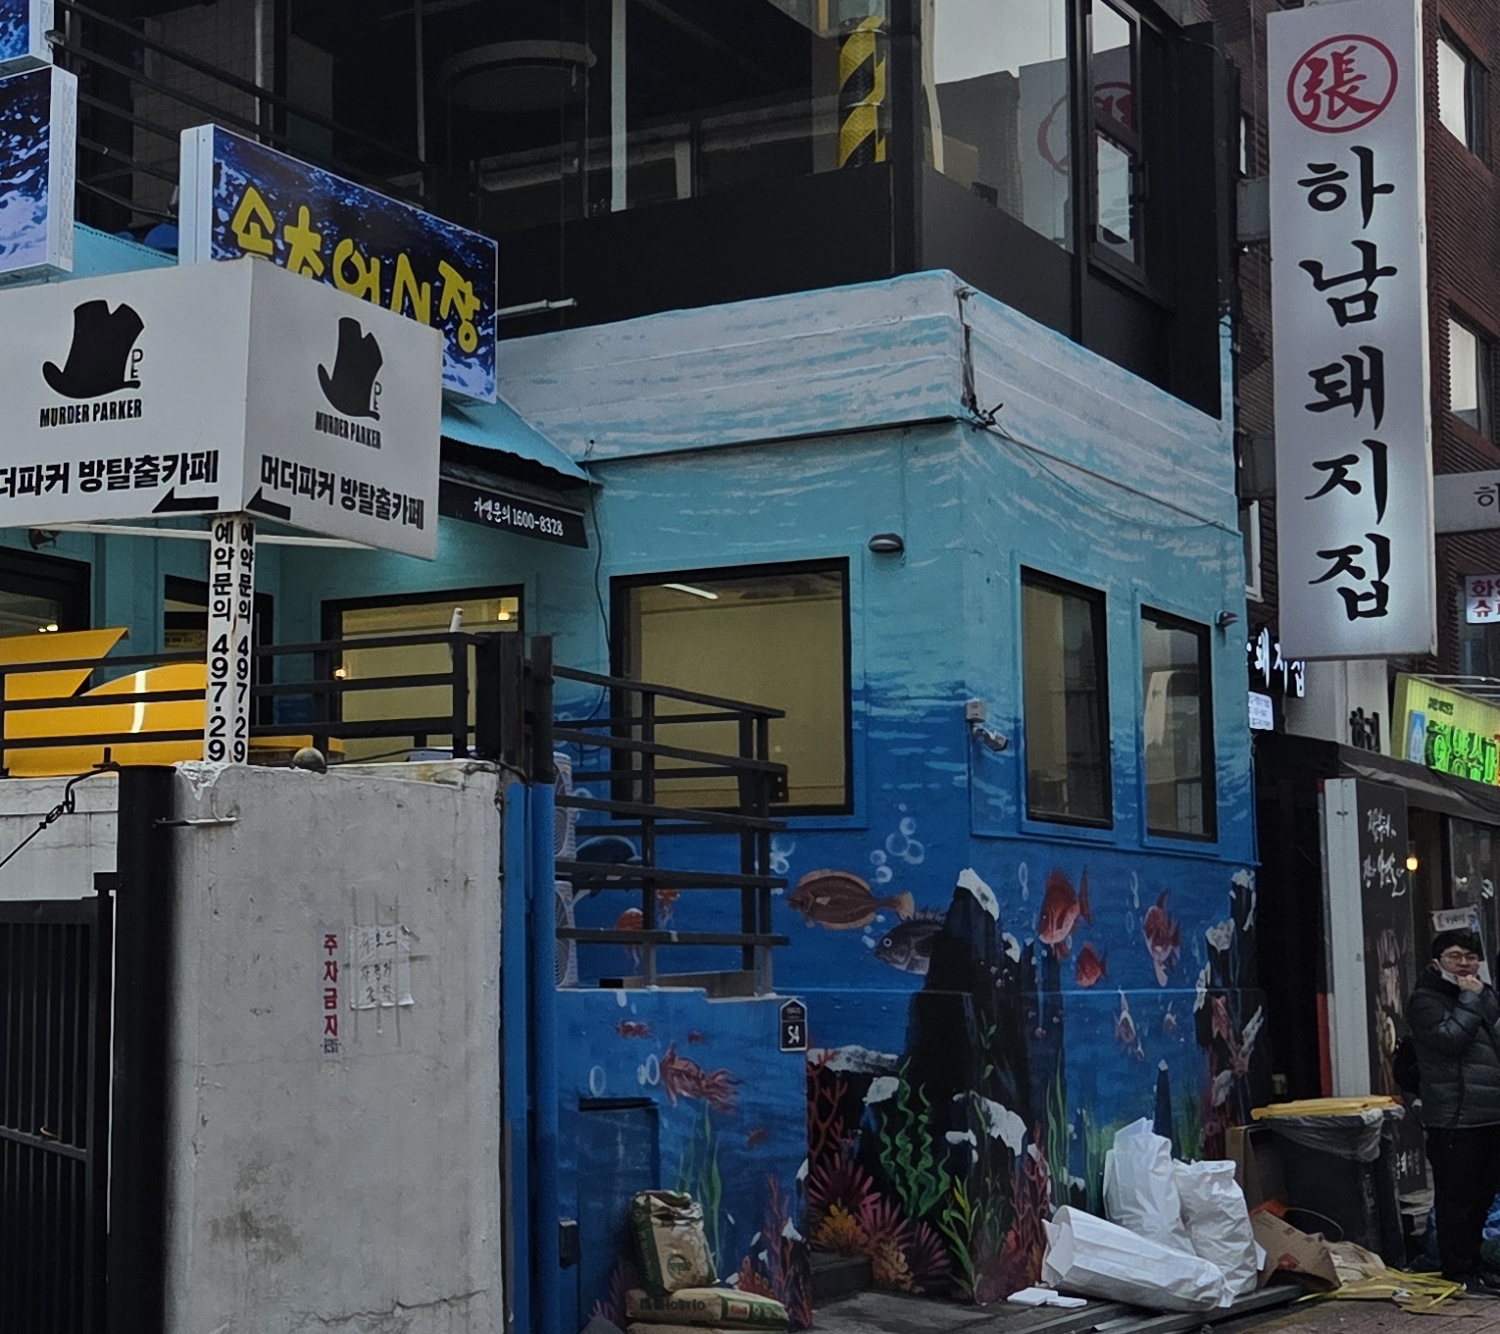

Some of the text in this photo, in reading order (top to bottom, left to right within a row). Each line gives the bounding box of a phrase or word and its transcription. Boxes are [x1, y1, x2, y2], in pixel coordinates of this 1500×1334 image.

[40, 398, 142, 428] MURDER PARKER
[1297, 144, 1398, 621] 하남돼지집
[79, 451, 219, 494] 방탈출카페
[262, 454, 424, 531] 머더파커 방탈출카페
[211, 520, 235, 622] 예약문의
[238, 522, 254, 624] 예약문의
[323, 934, 339, 1037] 주차금지
